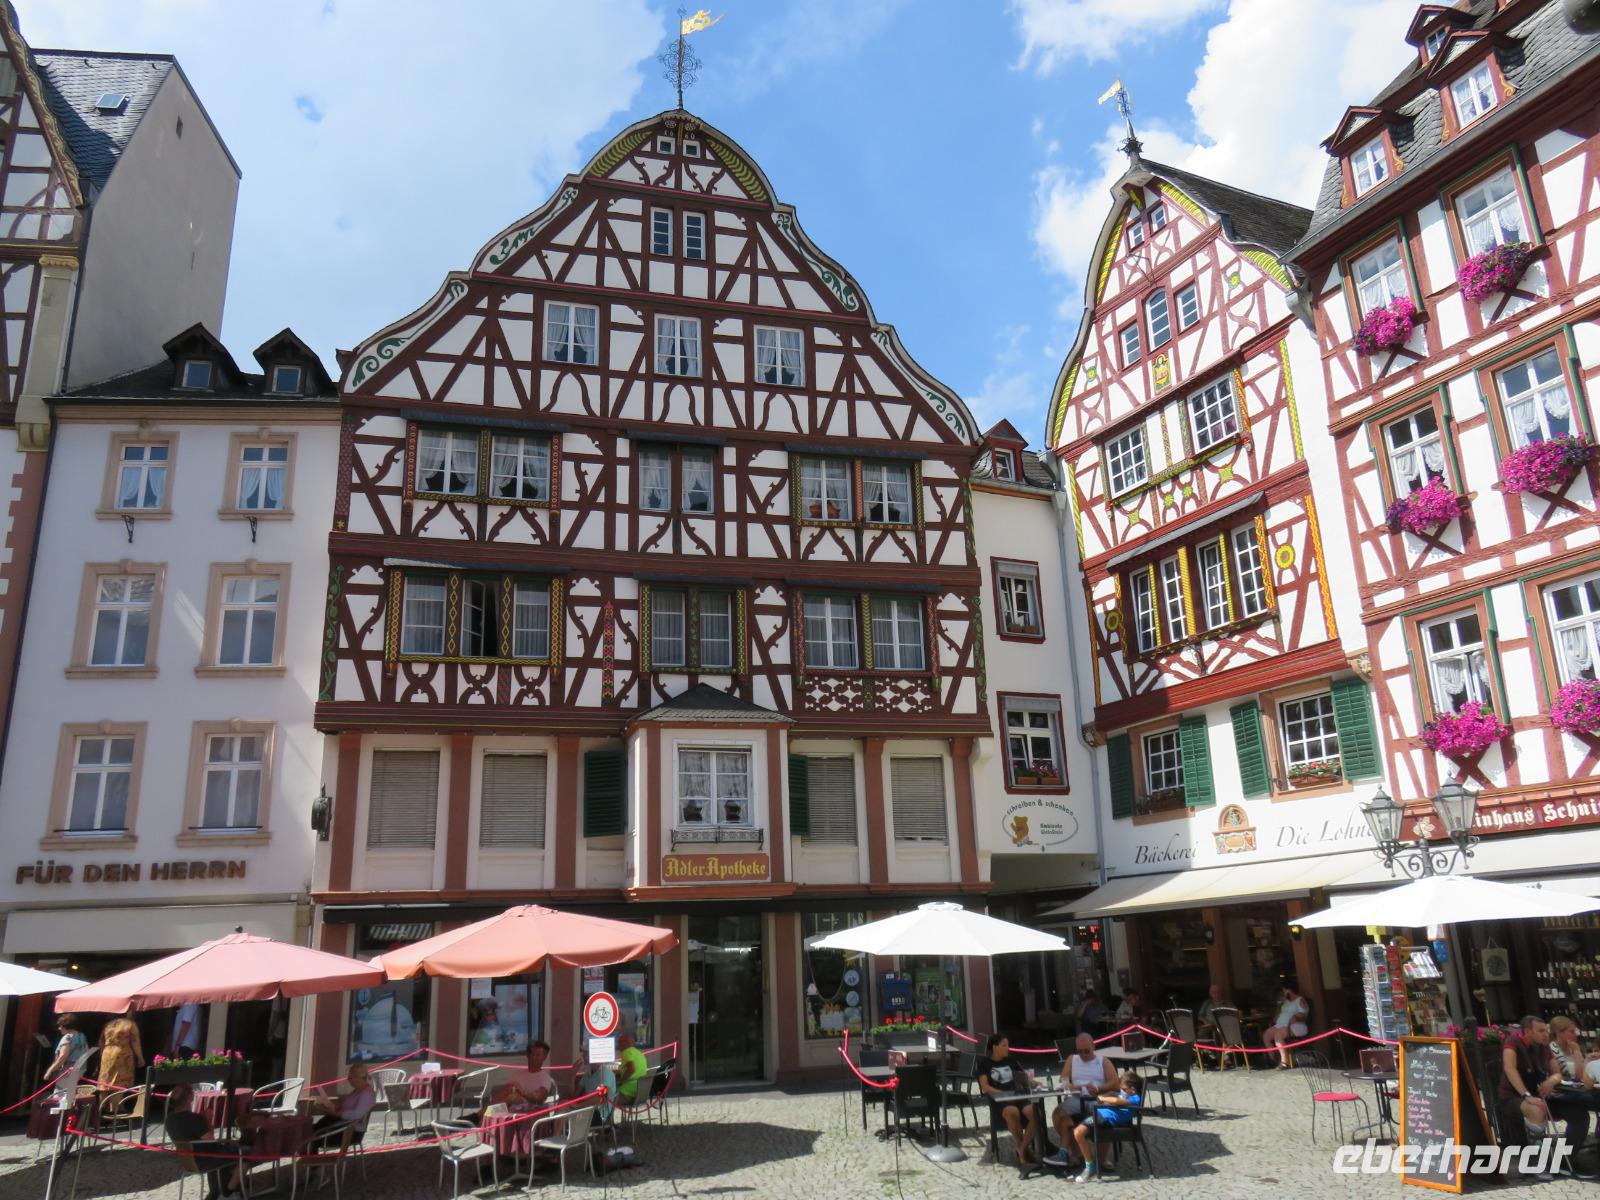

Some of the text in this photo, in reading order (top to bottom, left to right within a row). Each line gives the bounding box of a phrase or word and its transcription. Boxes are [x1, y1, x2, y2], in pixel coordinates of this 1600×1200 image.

[1472, 798, 1600, 830] inhaus Schni
[1277, 825, 1310, 847] Die
[1135, 833, 1199, 865] Bäckerei
[15, 860, 246, 884] FÜR DEN HERRN
[665, 856, 766, 879] Adler Apotheke
